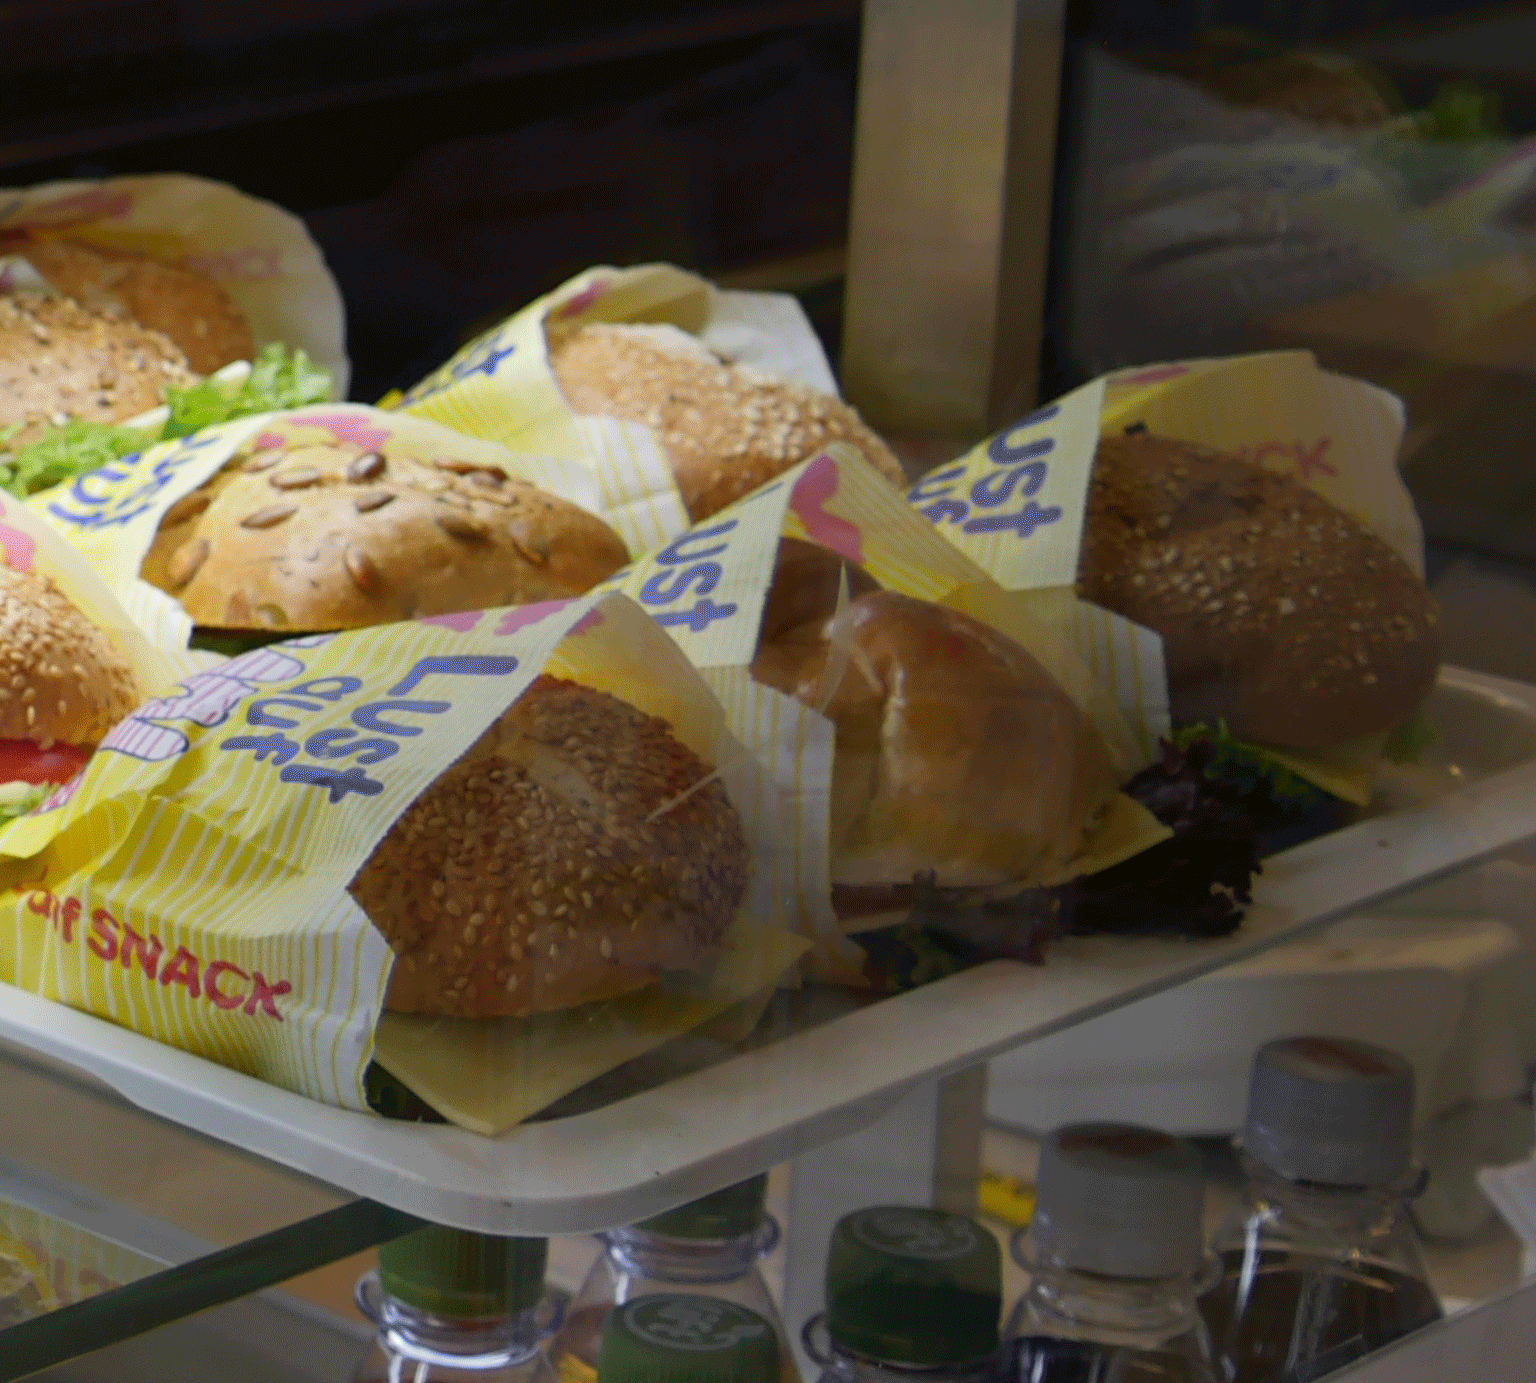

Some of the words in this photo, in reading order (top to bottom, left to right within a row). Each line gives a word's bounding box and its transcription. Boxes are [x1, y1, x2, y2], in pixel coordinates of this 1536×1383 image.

[962, 404, 1064, 539] ust
[639, 519, 738, 633] ust
[86, 907, 293, 1022] SNACK
